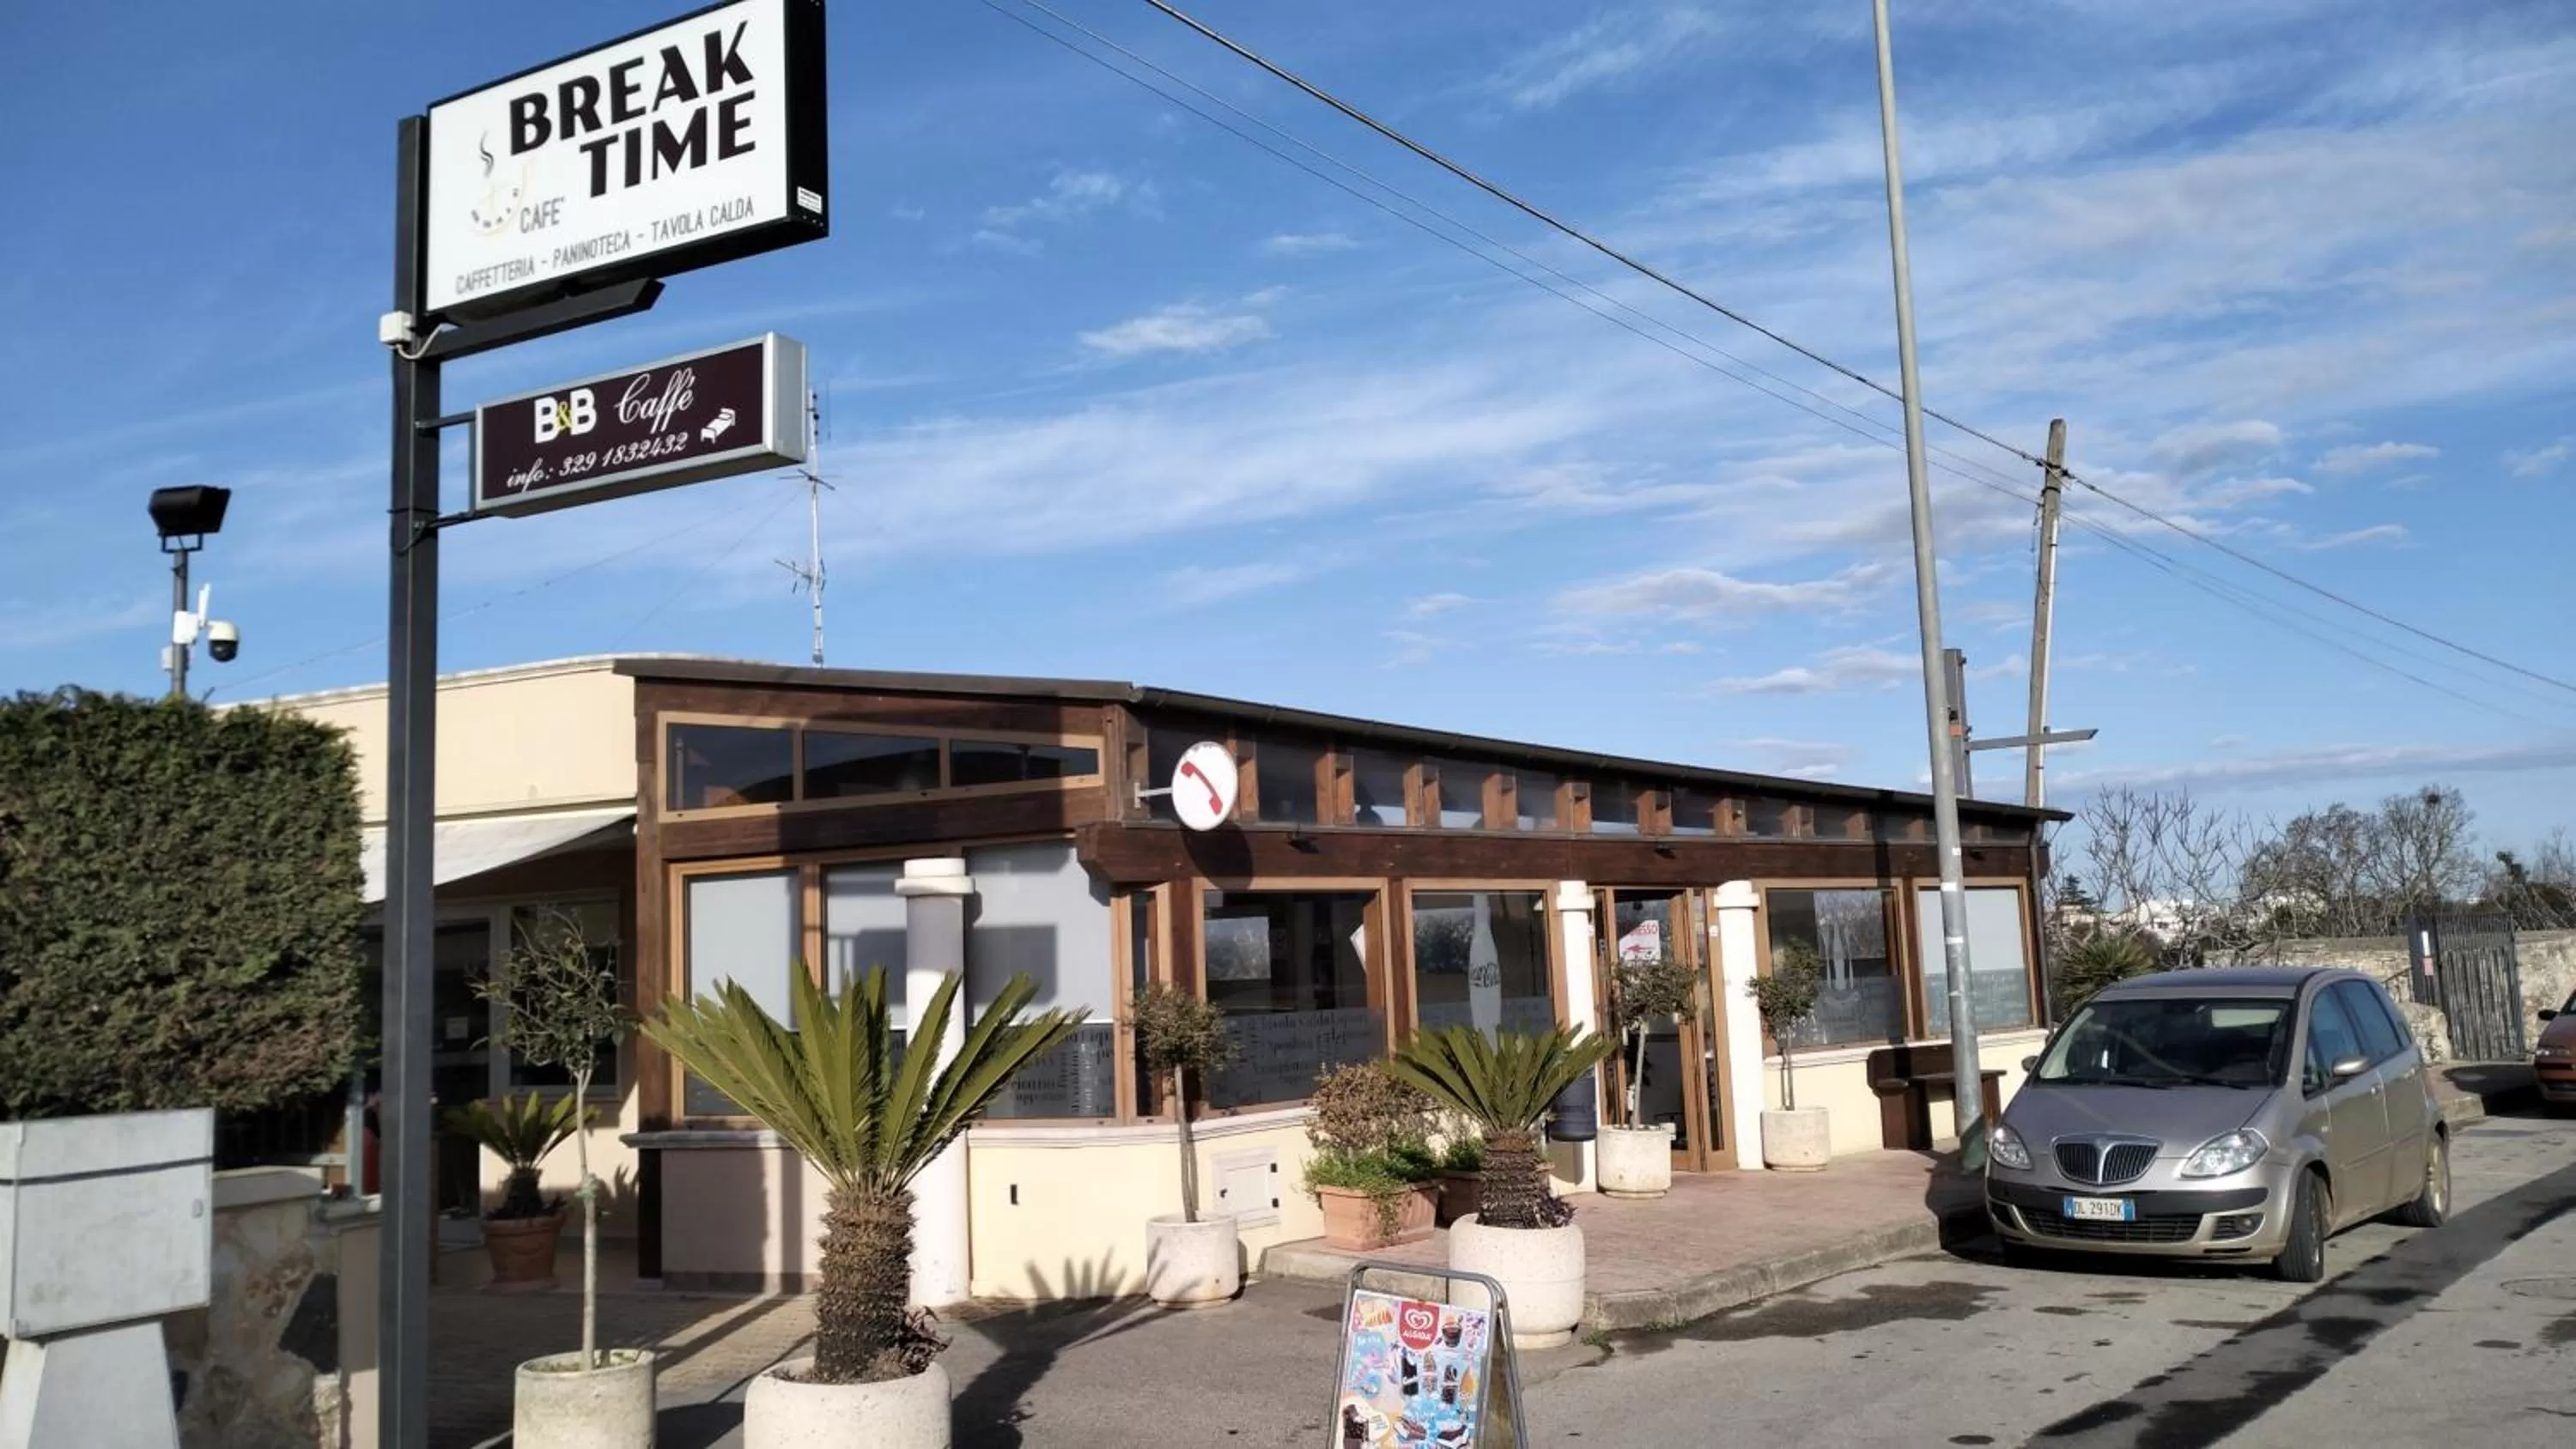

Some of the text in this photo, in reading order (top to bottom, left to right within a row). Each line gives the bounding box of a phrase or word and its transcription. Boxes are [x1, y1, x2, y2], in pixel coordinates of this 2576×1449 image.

[510, 21, 754, 155] BREAK
[580, 89, 756, 198] TIME
[455, 254, 535, 295] CAFFETTERIA
[552, 229, 631, 269] PANINOTECA
[652, 210, 703, 243] TAVOLA
[710, 196, 754, 226] CALDA
[533, 387, 597, 444] B&B
[558, 451, 597, 476] 329
[601, 432, 689, 467] 1832432
